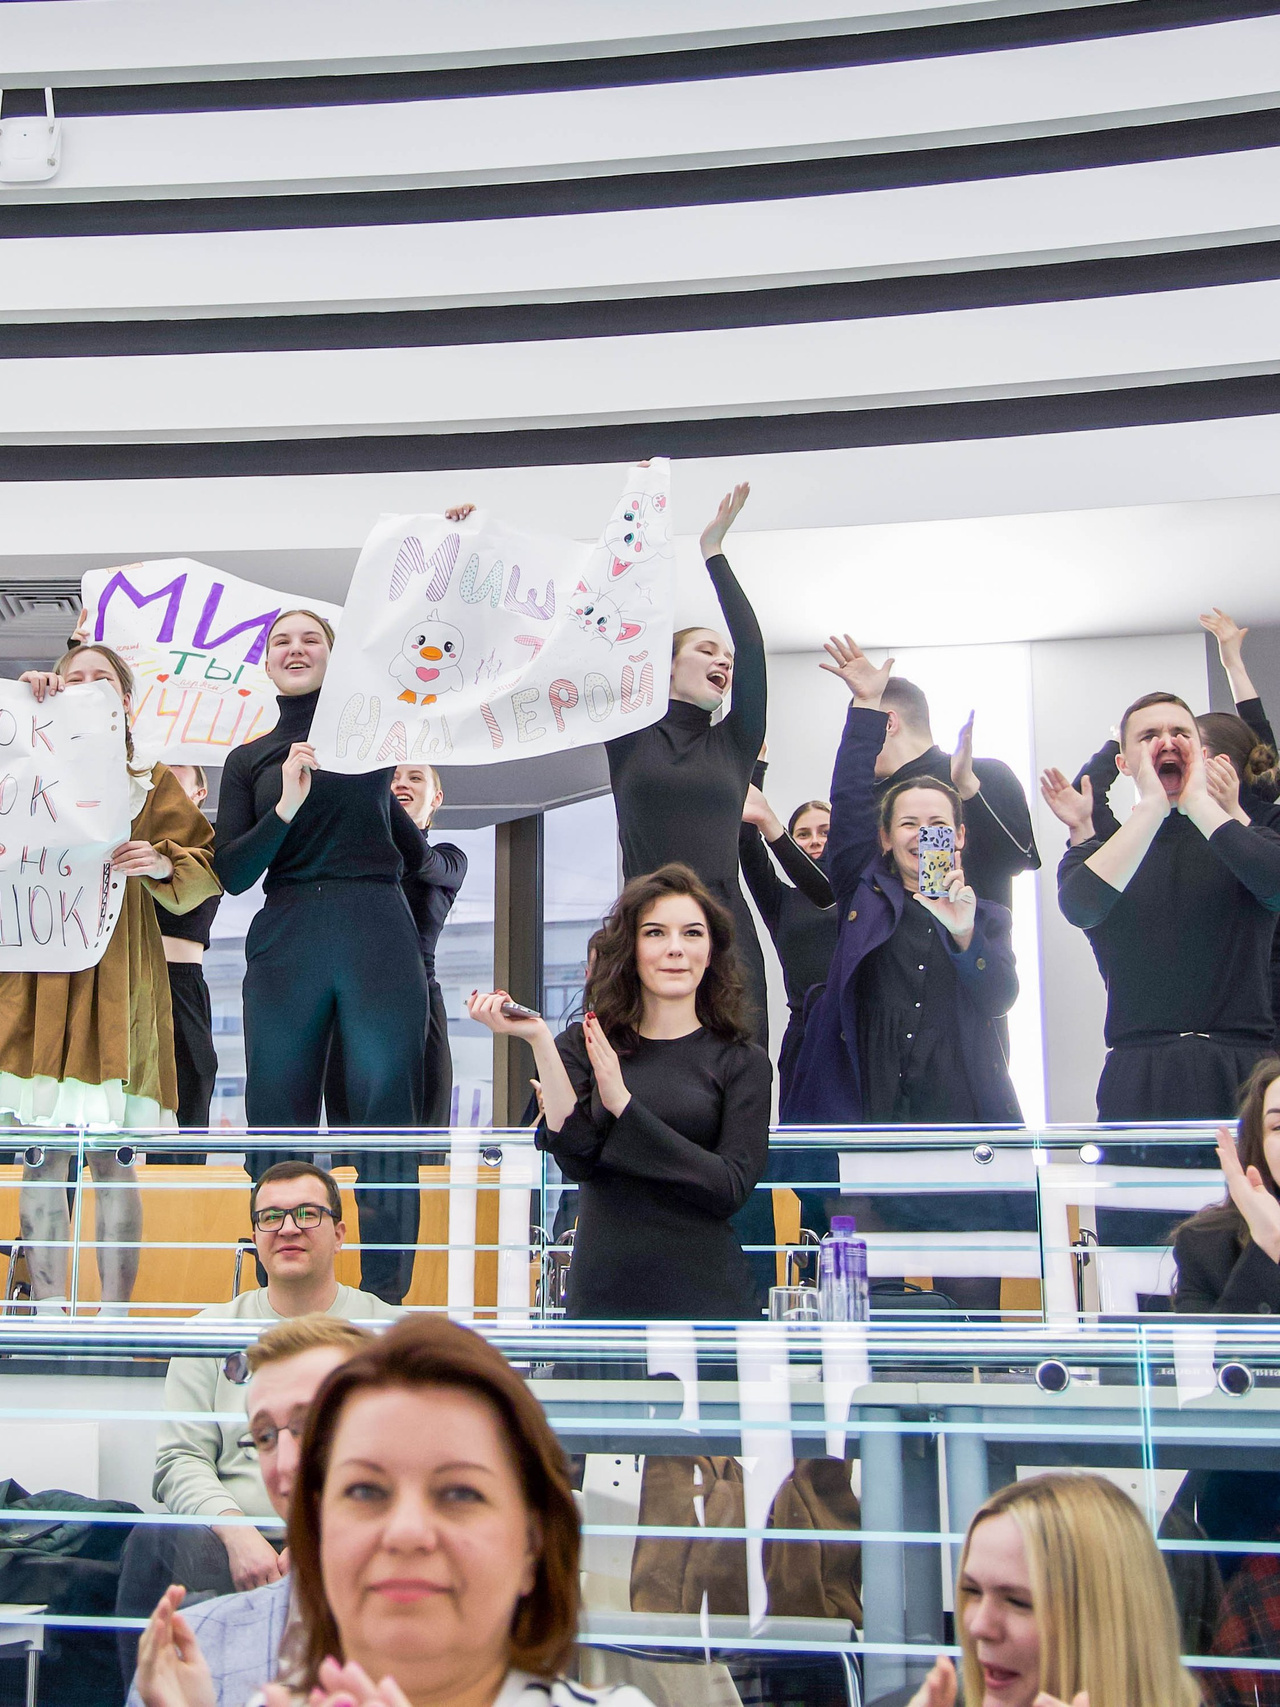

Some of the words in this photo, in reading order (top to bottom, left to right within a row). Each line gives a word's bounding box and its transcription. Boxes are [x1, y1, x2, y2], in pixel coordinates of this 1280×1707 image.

[95, 571, 329, 665] МИ
[169, 650, 245, 684] ТЫ
[336, 693, 453, 761] НАШ
[480, 650, 654, 750] ГЕРОЙ
